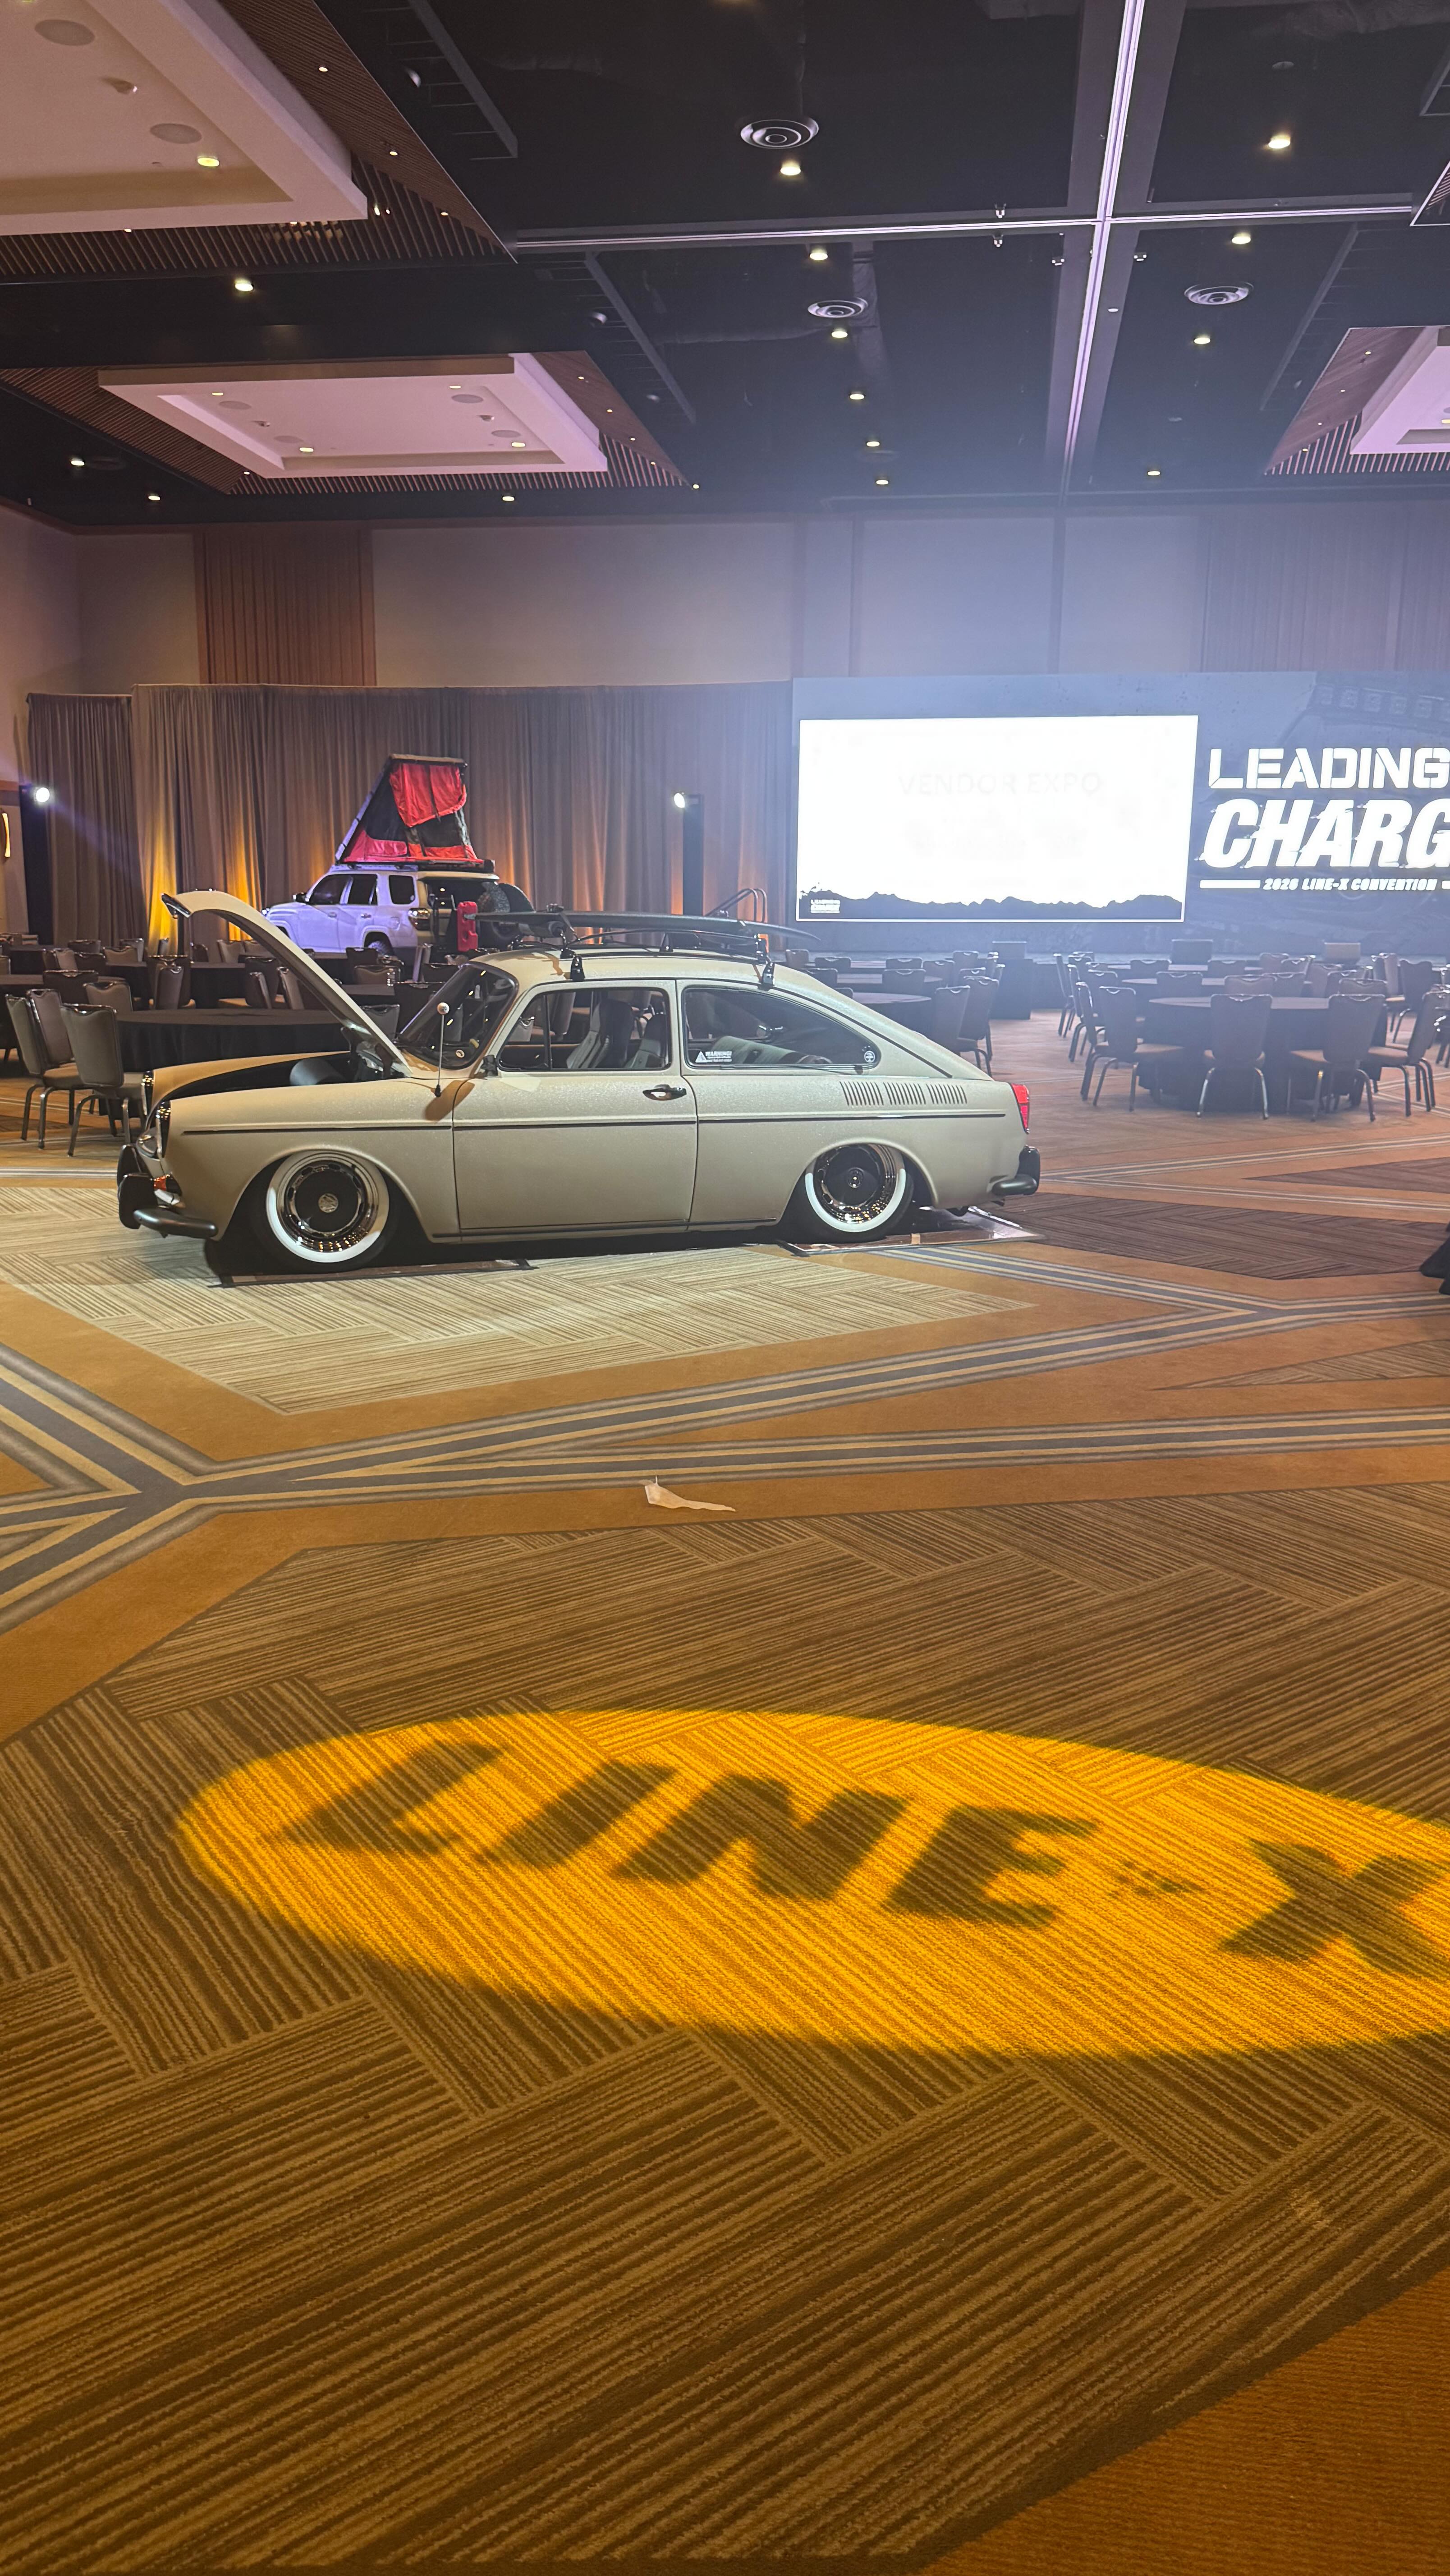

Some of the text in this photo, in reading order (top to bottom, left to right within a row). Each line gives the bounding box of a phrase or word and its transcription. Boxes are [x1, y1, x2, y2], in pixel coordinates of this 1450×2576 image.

[1208, 747, 1450, 789] LEADING
[898, 772, 1104, 796] VENDOR EXPO
[1262, 878, 1438, 891] 2026 LINE-X CONVENTION
